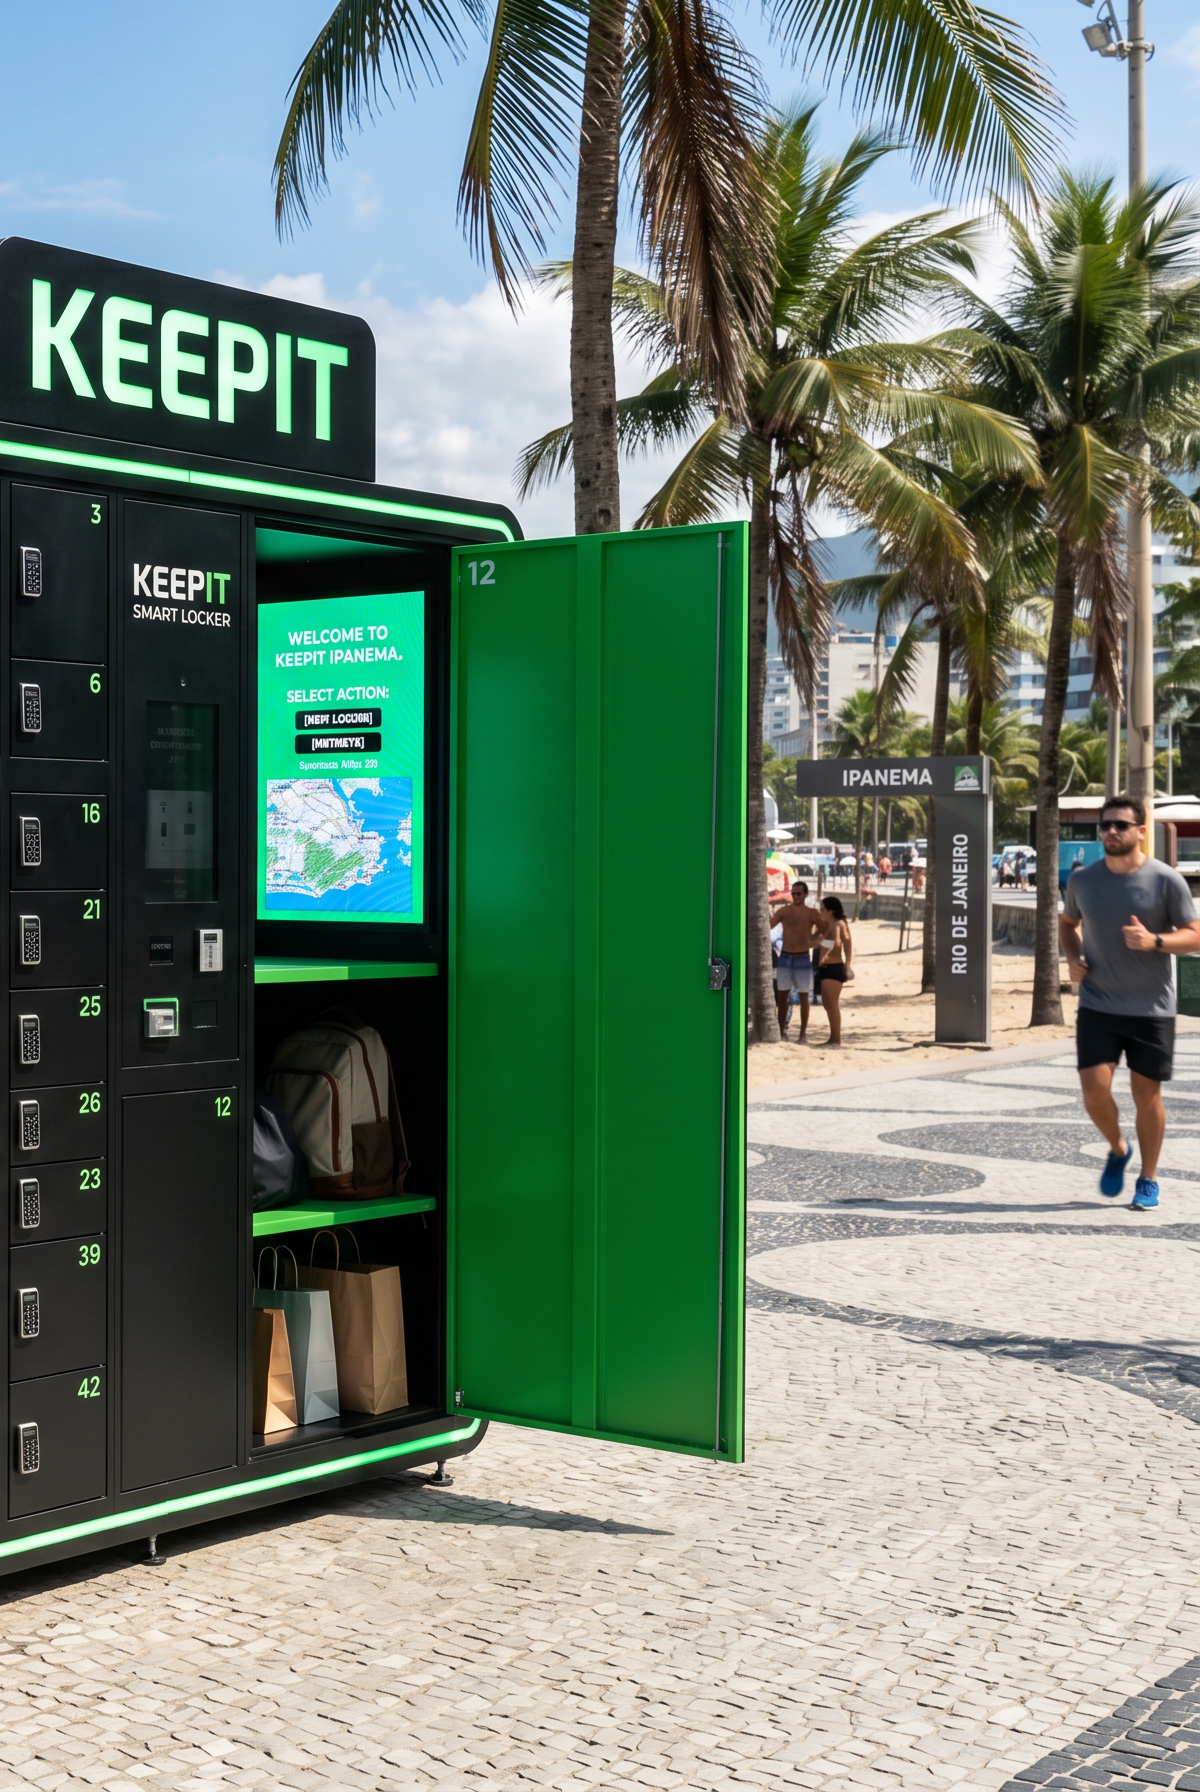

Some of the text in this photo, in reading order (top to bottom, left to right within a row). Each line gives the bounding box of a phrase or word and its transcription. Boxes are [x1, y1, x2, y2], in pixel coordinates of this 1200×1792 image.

[31, 278, 349, 442] KEEPIT
[90, 503, 102, 525] 3
[133, 563, 231, 605] KEEPIT
[467, 559, 496, 586] 12
[133, 603, 231, 628] SMART LOCKER
[287, 625, 389, 646] WELCOME TO
[275, 645, 403, 668] KEEPIT IPANEMA.
[89, 672, 101, 694] 6
[286, 685, 390, 704] SELECT ACTION:
[842, 768, 933, 787] IPANEMA
[81, 802, 101, 824] 16
[82, 898, 101, 920] 21
[951, 833, 969, 974] RIO DE JANEIRO
[79, 995, 101, 1017] 25
[78, 1091, 101, 1114] 26
[214, 1095, 232, 1117] 12
[79, 1167, 101, 1191] 23
[78, 1243, 101, 1267] 39
[77, 1375, 101, 1399] 42
